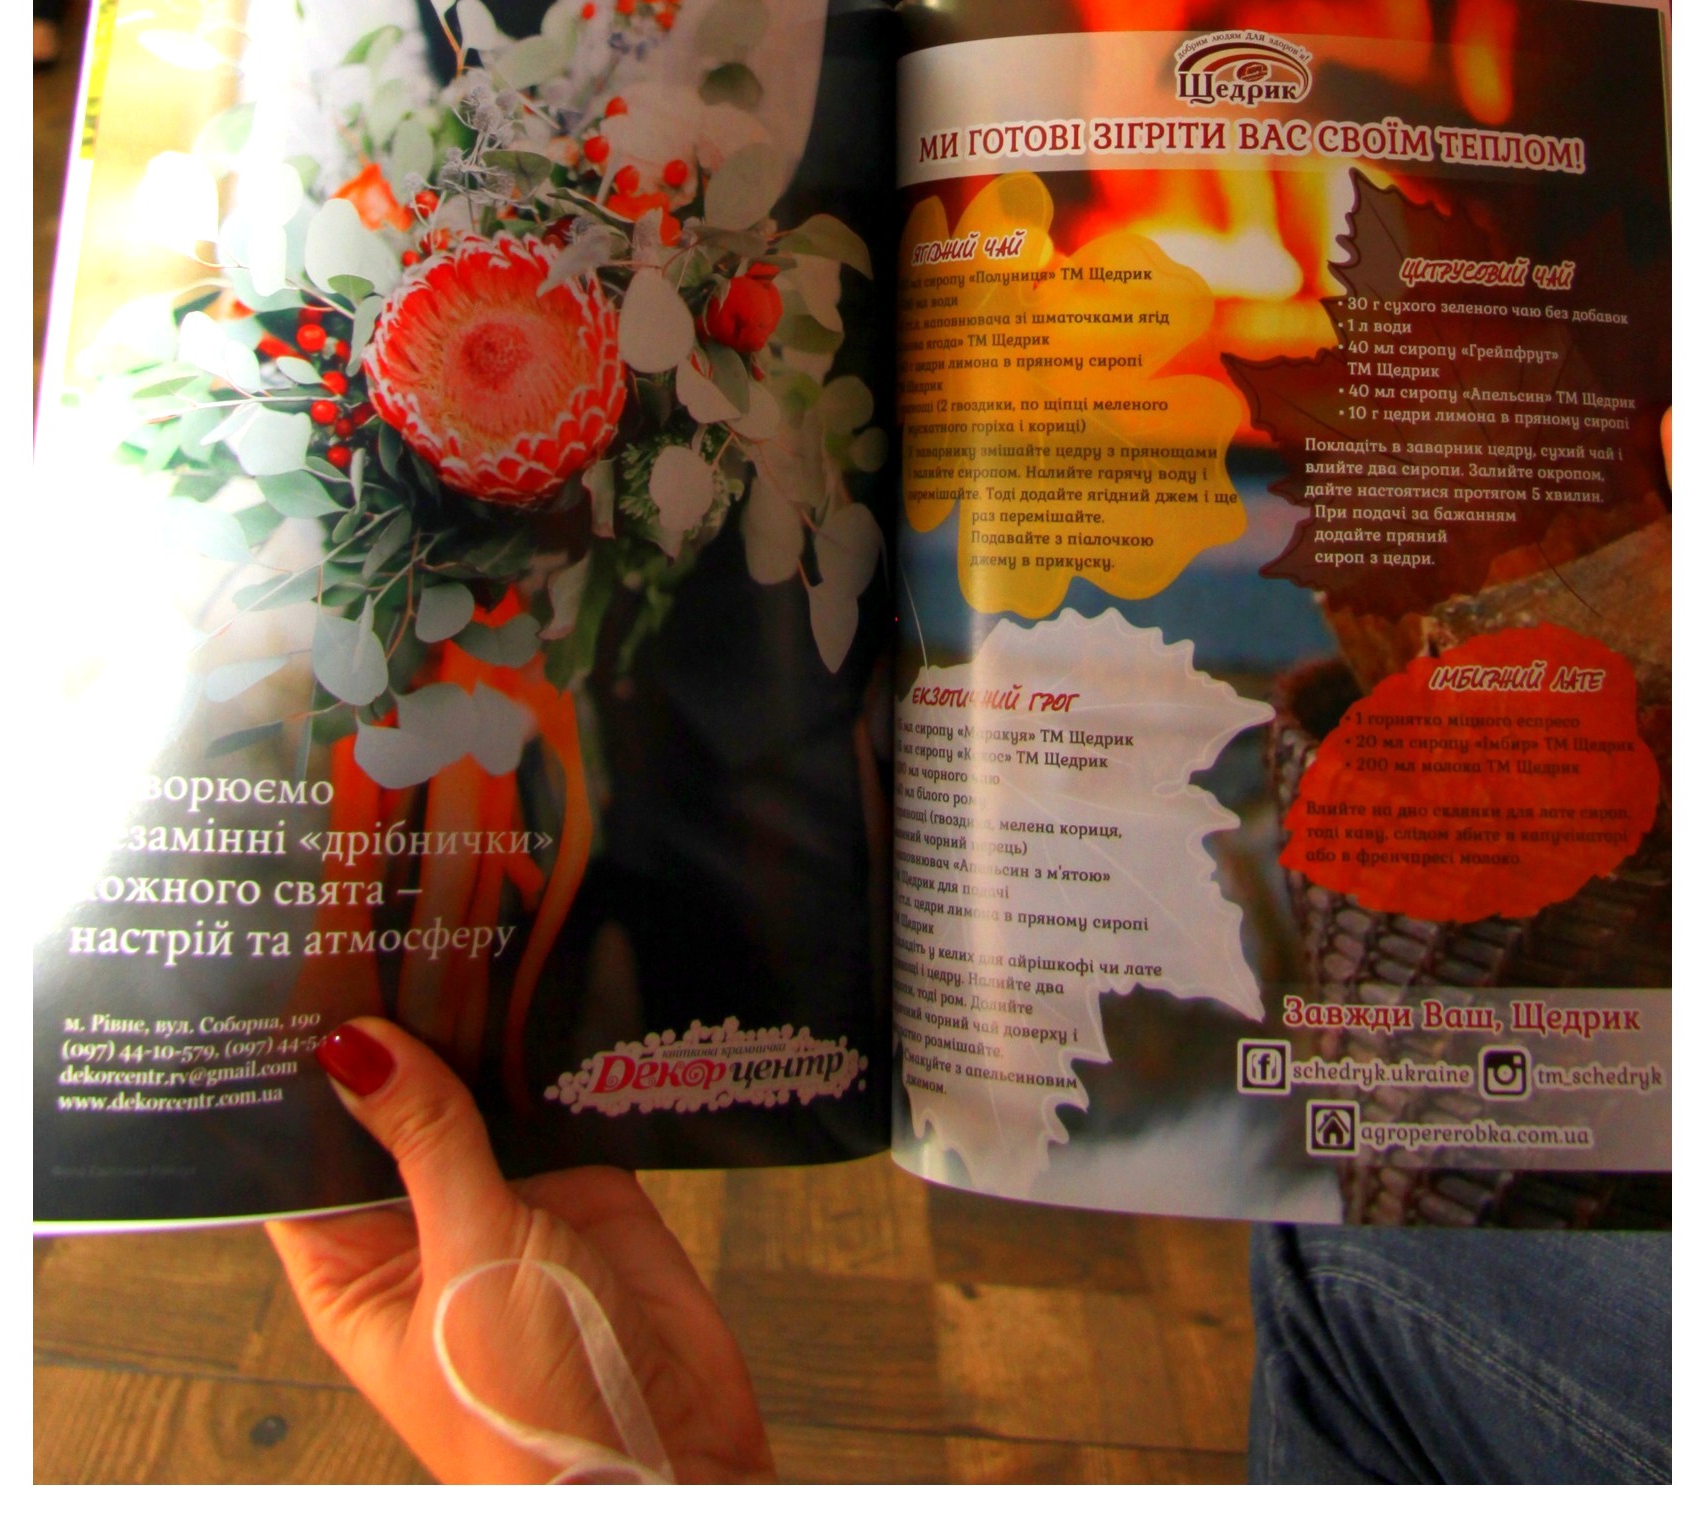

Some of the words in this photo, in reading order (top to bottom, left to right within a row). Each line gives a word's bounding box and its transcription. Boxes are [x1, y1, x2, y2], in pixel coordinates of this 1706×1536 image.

[1212, 33, 1241, 42] людям
[1245, 32, 1265, 41] ДЛЯ
[1178, 73, 1296, 104] Щедрик
[919, 132, 959, 163] МИ
[969, 124, 1081, 156] ГОТОВІ
[1093, 122, 1225, 150] ЗІГРІТИ
[1239, 123, 1306, 151] ВАС
[1319, 121, 1429, 157] СВОЇМ
[1440, 131, 1582, 169] ТЕПЛОМ!
[984, 230, 1025, 258] ЧАЙ
[969, 270, 1055, 285] «Полуниця»
[1061, 268, 1083, 280] ТМ
[1089, 267, 1152, 284] Щедрик
[1401, 258, 1529, 286] ЦИТРУСОВИЙ
[1533, 263, 1575, 289] ЧАЙ
[1032, 313, 1133, 324] шматочками
[1138, 311, 1170, 325] ягід
[1348, 297, 1368, 311] 30
[1384, 301, 1436, 315] сухого
[1441, 302, 1508, 315] зеленого
[1512, 305, 1541, 318] чаю
[1572, 309, 1628, 324] добавок
[1373, 321, 1412, 335] води
[967, 335, 987, 346] ТМ
[992, 334, 1050, 349] Щедрик
[948, 358, 998, 369] лимона
[1016, 356, 1083, 370] пряному
[1089, 354, 1142, 369] сиропі
[1348, 341, 1369, 354] 40
[1399, 345, 1456, 360] сиропу
[1461, 343, 1559, 364] «Грейпфрут»
[1348, 362, 1371, 375] ТМ
[1377, 363, 1440, 380] Щедрик
[1093, 399, 1168, 412] меленого
[1349, 384, 1369, 398] 40
[1400, 389, 1457, 403] сиропу
[1463, 388, 1552, 403] «Апельсин»
[1555, 391, 1578, 405] ТМ
[1582, 393, 1636, 410] Щедрик
[1349, 406, 1367, 420] 10
[1383, 409, 1431, 424] цедри
[1435, 410, 1496, 422] лимона
[1515, 413, 1580, 430] пряному
[1583, 416, 1630, 431] сиропі
[1056, 446, 1102, 460] цедру
[1120, 446, 1217, 460] прянощами
[1305, 438, 1386, 453] Покладіть
[1406, 441, 1482, 457] заварник
[1488, 444, 1536, 459] цедру,
[1540, 444, 1585, 459] сухий
[1589, 446, 1614, 459] чай
[1025, 465, 1093, 479] Налийте
[1097, 469, 1152, 483] гарячу
[1158, 469, 1197, 484] воду
[1305, 461, 1363, 474] влийте
[1368, 463, 1397, 477] два
[1402, 463, 1464, 479] сиропи.
[1469, 463, 1533, 479] Залийте
[1537, 467, 1605, 483] окропом,
[1020, 488, 1082, 502] додайте
[1087, 489, 1149, 503] ягідний
[1155, 491, 1198, 504] джем
[1305, 483, 1352, 498] дайте
[1357, 485, 1449, 498] настоятися
[1454, 487, 1526, 503] протягом
[1545, 490, 1604, 503] хвилин.
[999, 509, 1104, 525] перемішайте.
[1315, 504, 1346, 520] При
[1352, 506, 1406, 522] подачі
[1434, 507, 1517, 522] бажанням
[971, 530, 1050, 546] Подавайте
[1067, 533, 1154, 547] піалочкою
[1314, 528, 1381, 544] додайте
[1386, 529, 1447, 546] пряний
[1036, 555, 1115, 572] прикуску.
[1315, 551, 1364, 567] сироп
[1383, 552, 1435, 566] цедри.
[1429, 661, 1546, 691] ІМБИРНИЙ
[1028, 692, 1080, 712] ГРОГ
[1040, 729, 1063, 743] ТМ
[1069, 731, 1134, 748] Щедрик
[1016, 750, 1039, 764] ТМ
[1044, 752, 1108, 770] Щедрик
[139, 774, 334, 812] ворюємо
[999, 820, 1054, 834] мелена
[1059, 823, 1122, 839] кориця,
[115, 817, 288, 855] замінні
[299, 820, 554, 867] «дрібнички»
[92, 875, 262, 906] ожного
[273, 878, 385, 907] свята
[1018, 912, 1088, 931] пряному
[1093, 917, 1149, 933] сиропі
[68, 920, 235, 967] настрій
[246, 930, 292, 958] та
[303, 916, 517, 962] атмосферу
[1008, 955, 1094, 976] айрішкофі
[1124, 964, 1162, 976] лате
[90, 1013, 151, 1036] Рівне,
[155, 1018, 195, 1039] вул.
[1284, 996, 1412, 1034] Завжди
[1423, 1001, 1502, 1032] Ваш,
[1512, 1003, 1641, 1038] Щедрик
[60, 1038, 116, 1063] (097)
[224, 1036, 275, 1059] (097)
[58, 1059, 299, 1088] dekorcentr.rv@gmail.com
[965, 1066, 1078, 1088] апельсиновим
[1293, 1060, 1470, 1086] schedryk.ukraine
[1537, 1064, 1663, 1091] tm_schedryk
[56, 1086, 284, 1112] www.dekorcentr.com.ua
[1361, 1123, 1590, 1147] agropererobka.com.ua
